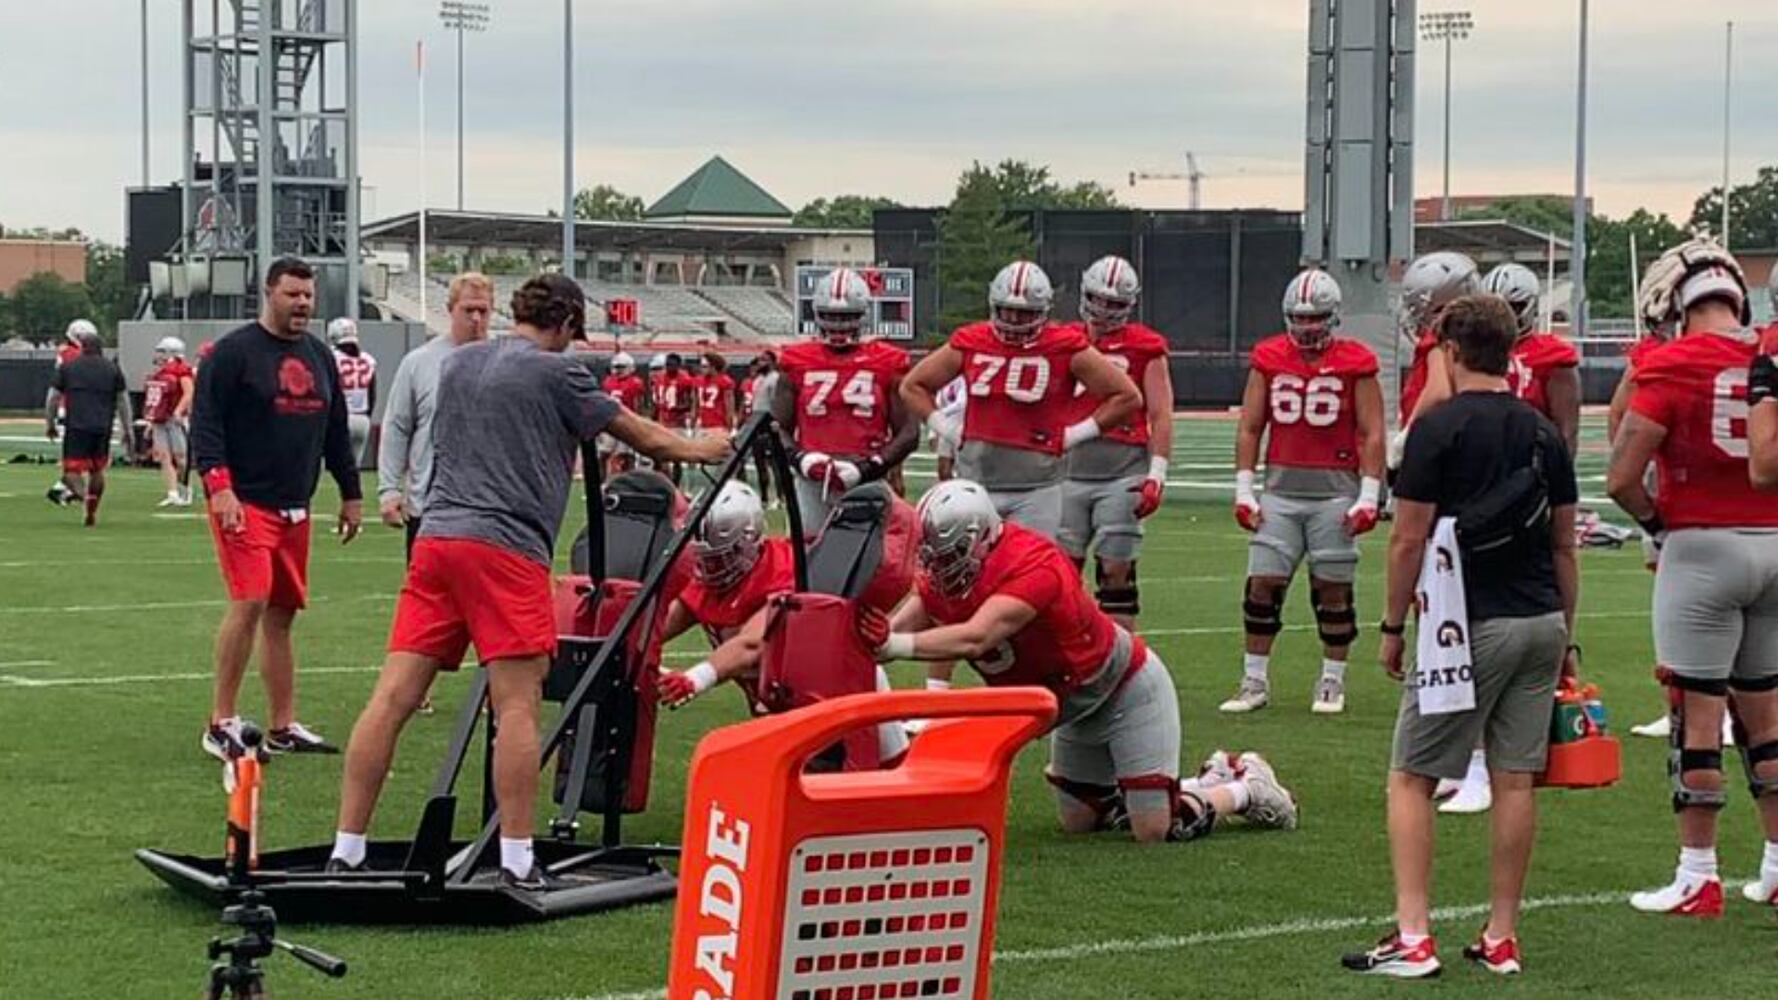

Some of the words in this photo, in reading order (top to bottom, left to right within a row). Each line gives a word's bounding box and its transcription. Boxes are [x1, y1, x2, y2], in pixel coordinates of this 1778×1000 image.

[340, 359, 370, 390] 22
[803, 369, 876, 418] 74
[970, 353, 1050, 403] 70
[1270, 373, 1344, 427] 66
